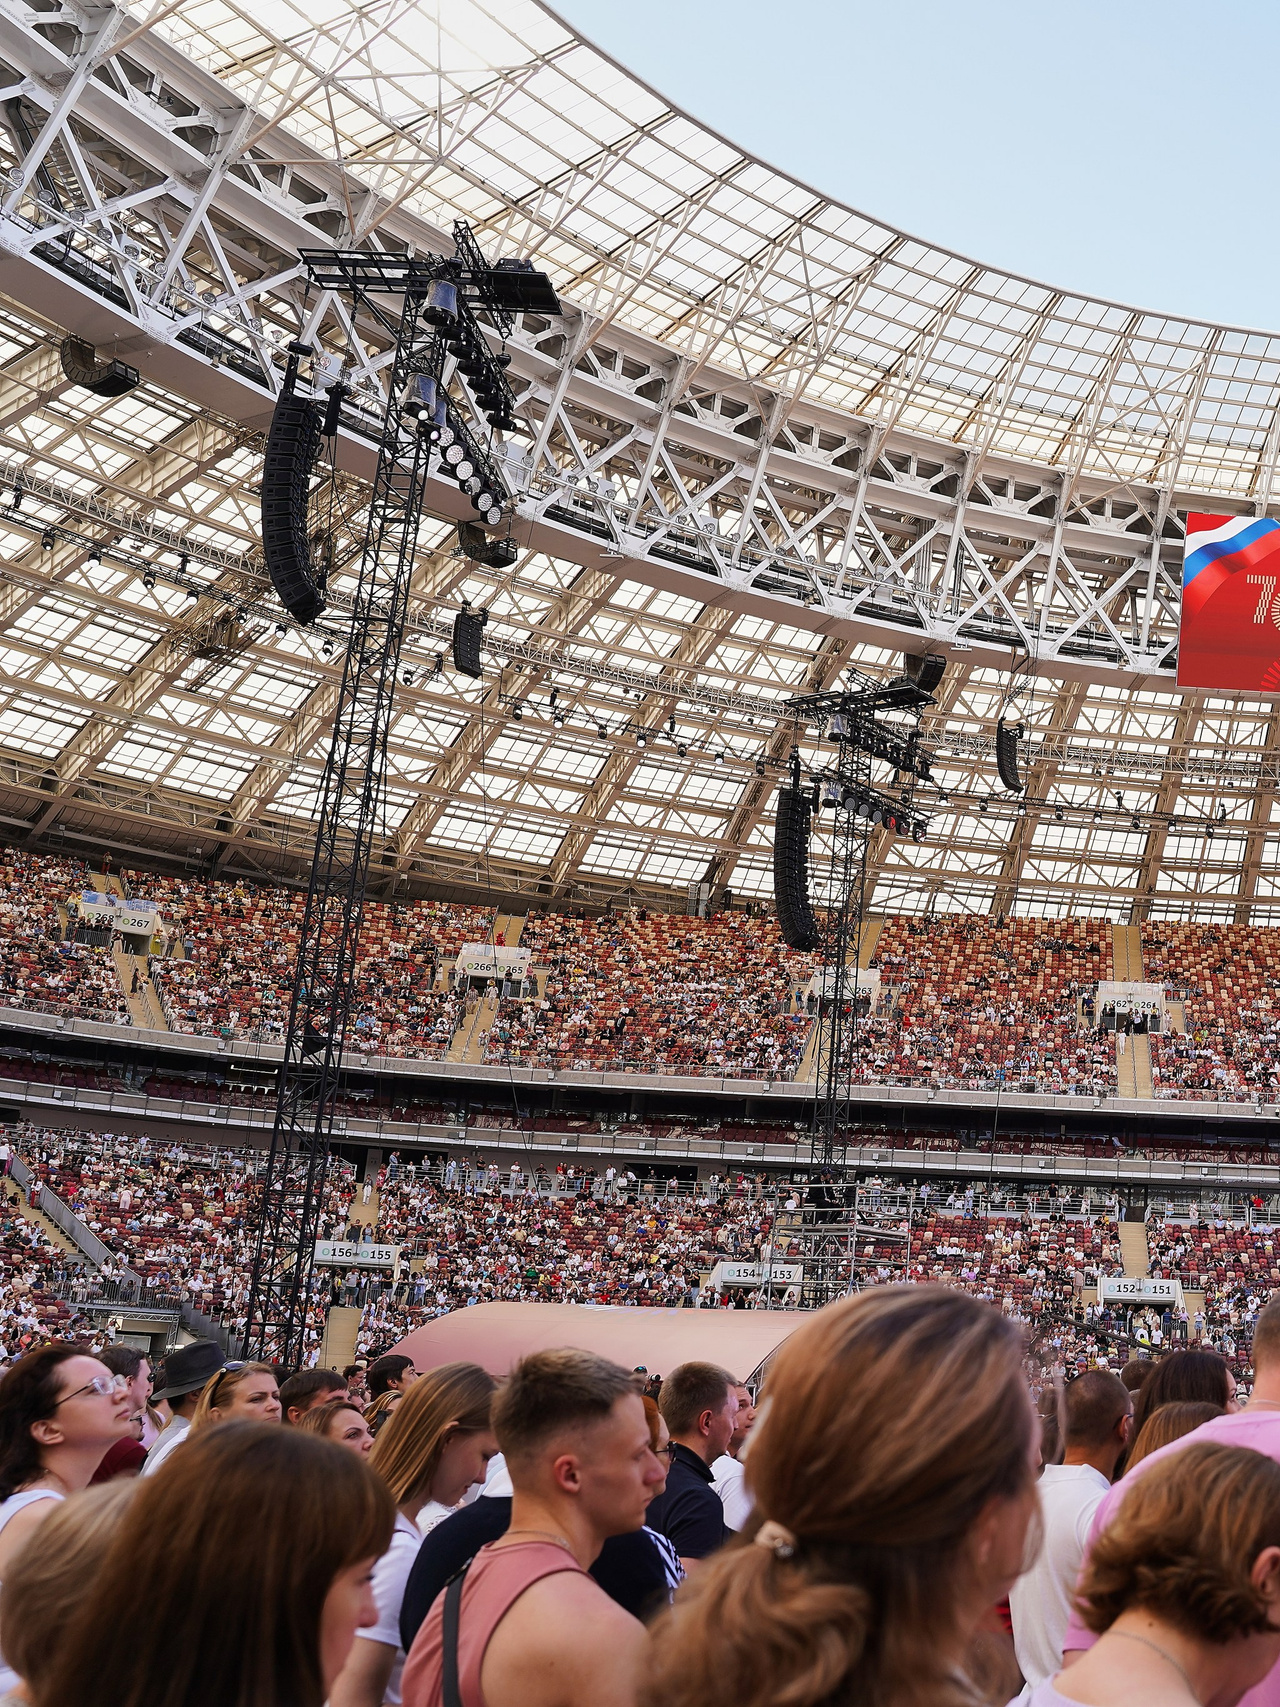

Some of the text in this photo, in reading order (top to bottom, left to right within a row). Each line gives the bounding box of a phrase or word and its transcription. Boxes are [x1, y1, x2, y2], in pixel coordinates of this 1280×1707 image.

[130, 918, 150, 929] 267
[473, 962, 492, 972] 266
[331, 1248, 391, 1260] 156 155
[736, 1268, 792, 1279] 154 153
[1116, 1284, 1171, 1294] 152 151
